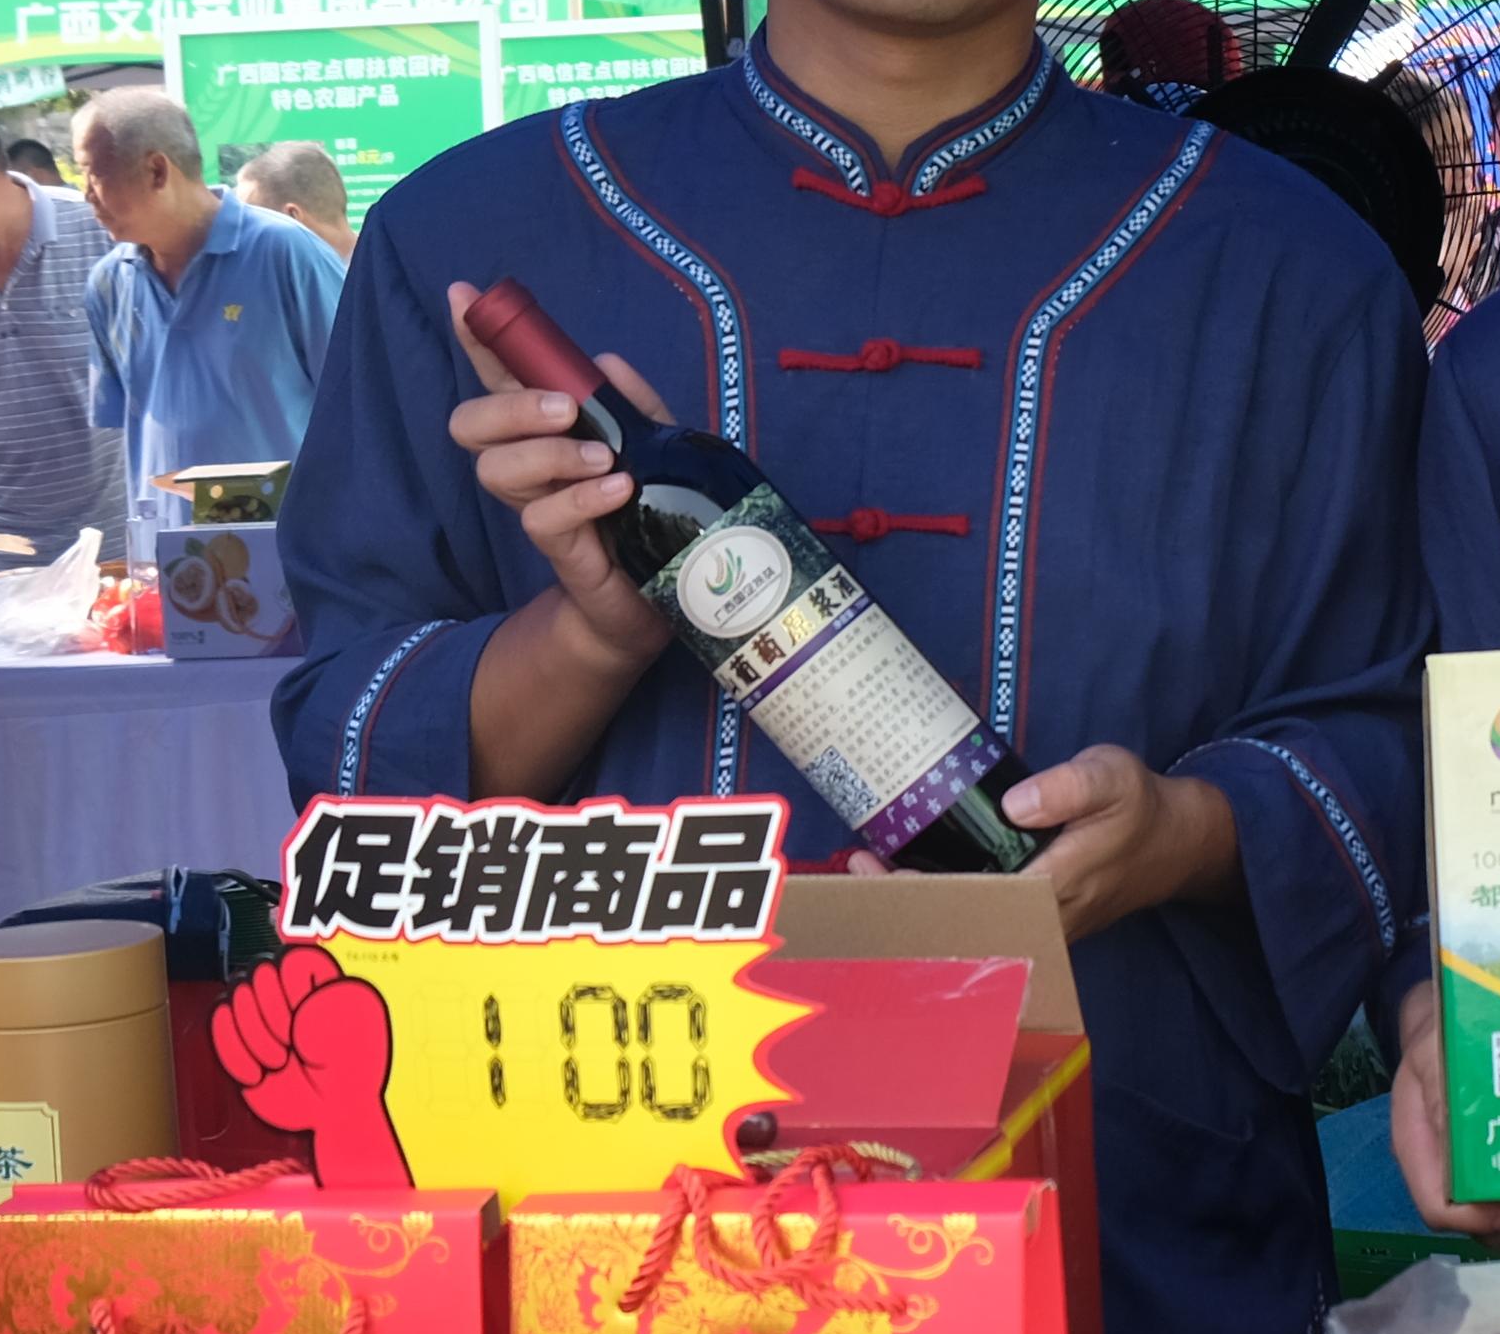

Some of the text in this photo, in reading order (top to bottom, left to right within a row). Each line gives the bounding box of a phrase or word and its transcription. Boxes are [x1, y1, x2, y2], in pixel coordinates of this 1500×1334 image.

[271, 84, 399, 111] 特色农副产品
[290, 813, 783, 934] 促销商品
